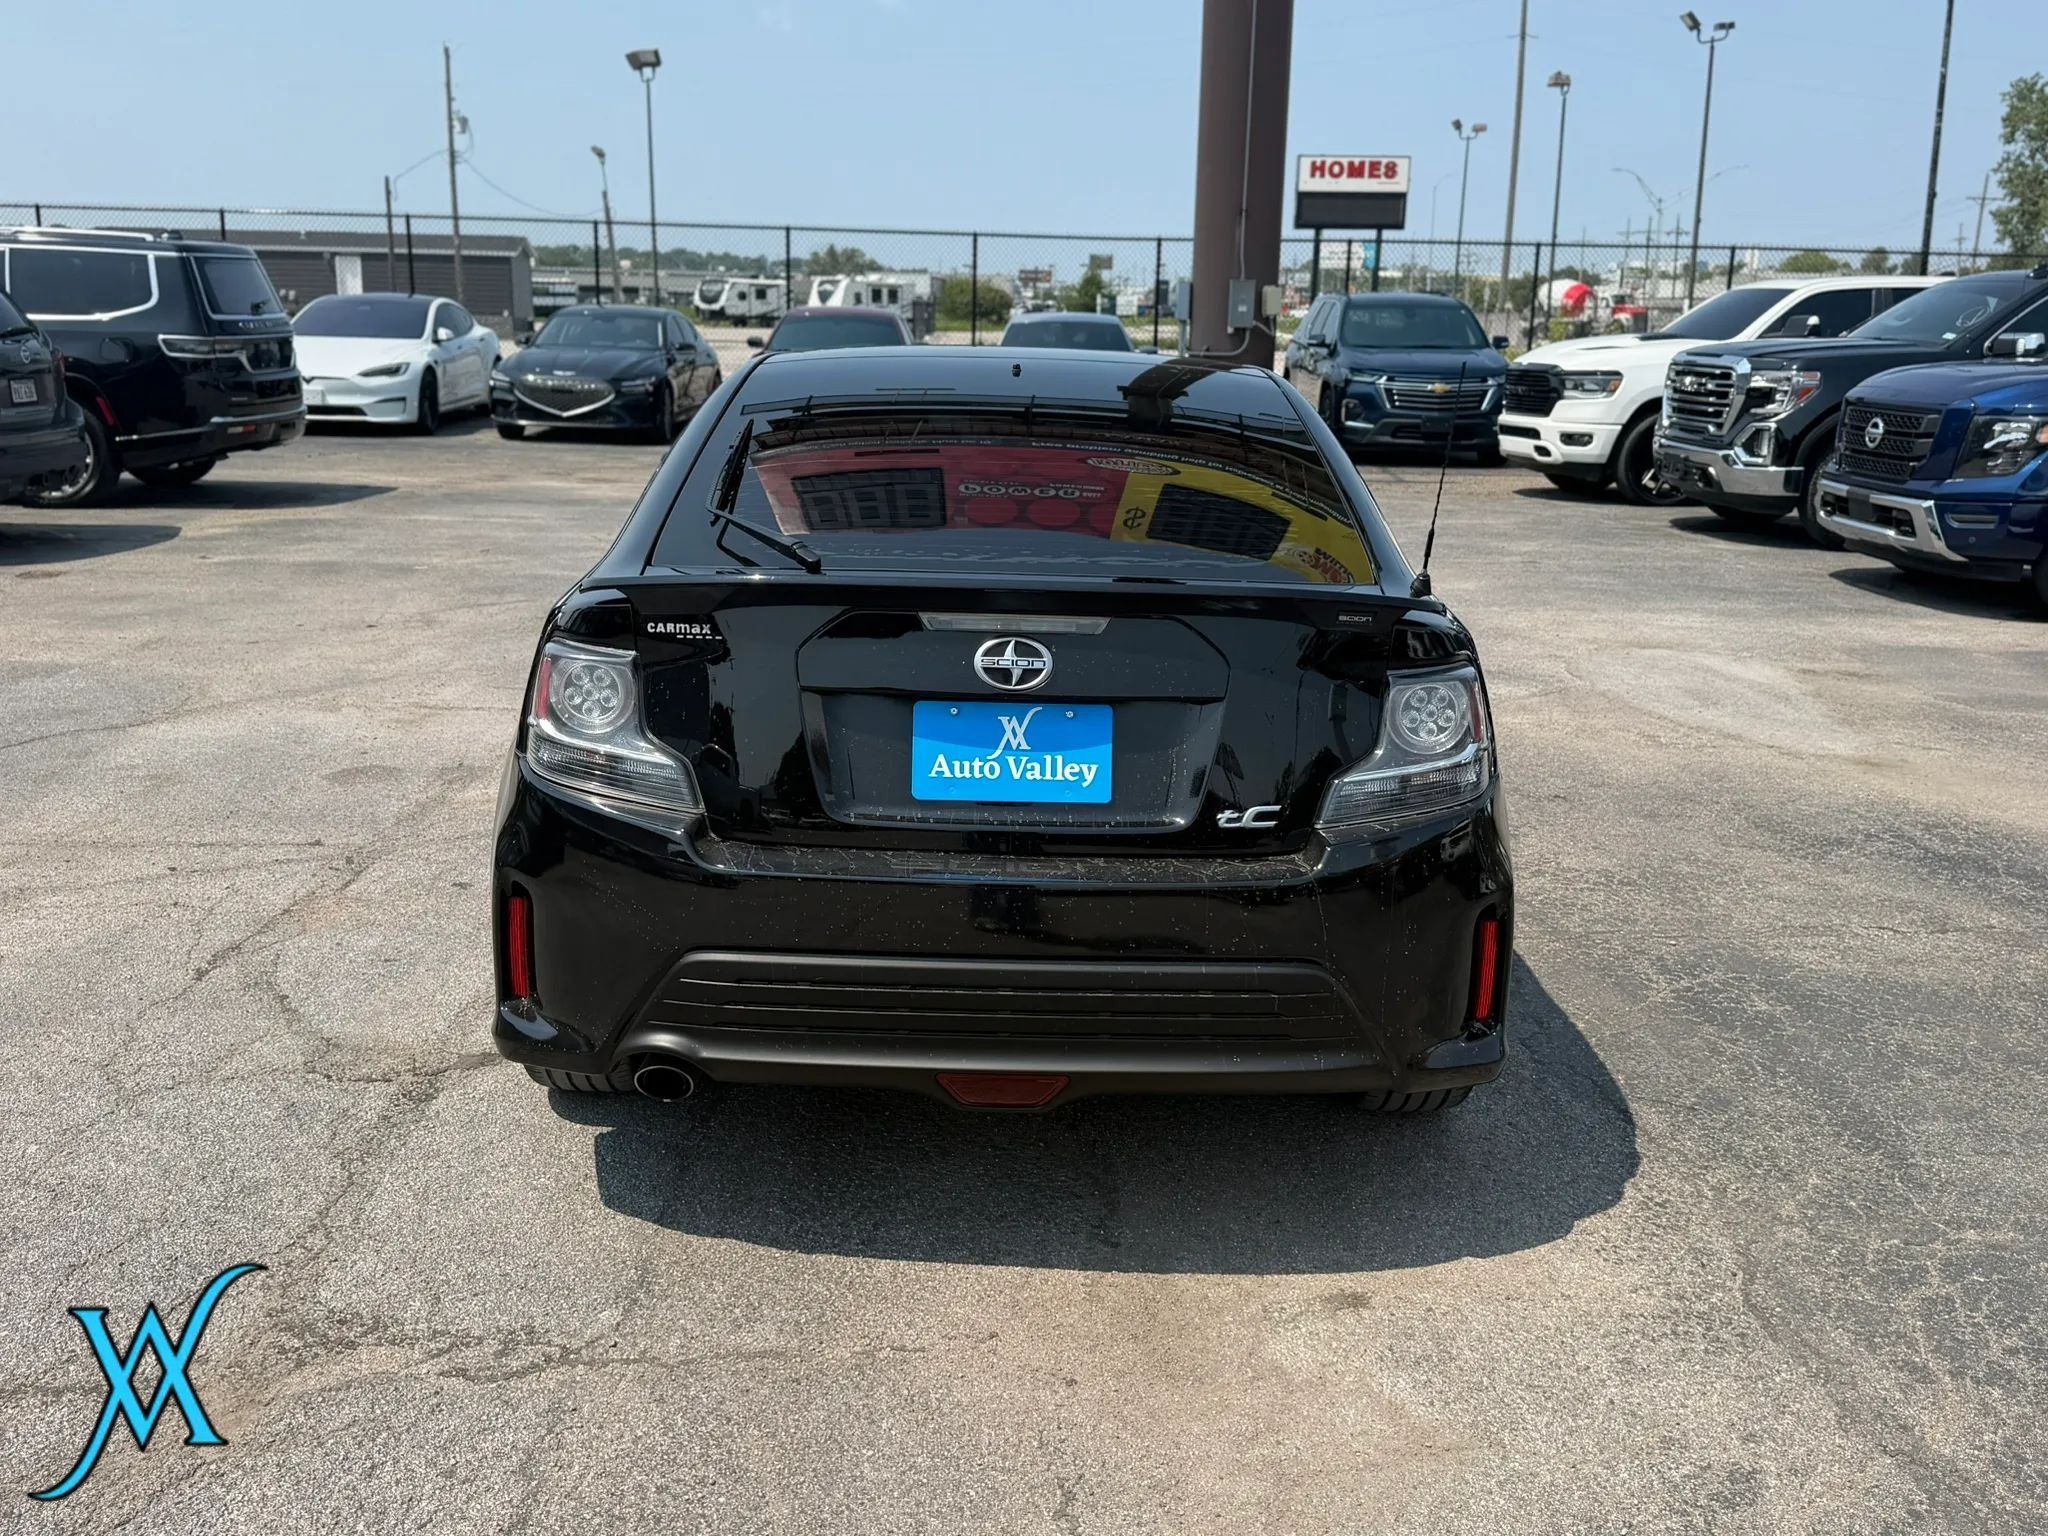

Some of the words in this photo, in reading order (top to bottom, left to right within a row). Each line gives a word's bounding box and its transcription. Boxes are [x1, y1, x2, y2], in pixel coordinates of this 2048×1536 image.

[980, 658, 1046, 668] SCION
[928, 753, 1000, 780] Auto
[1005, 754, 1099, 788] Valley
